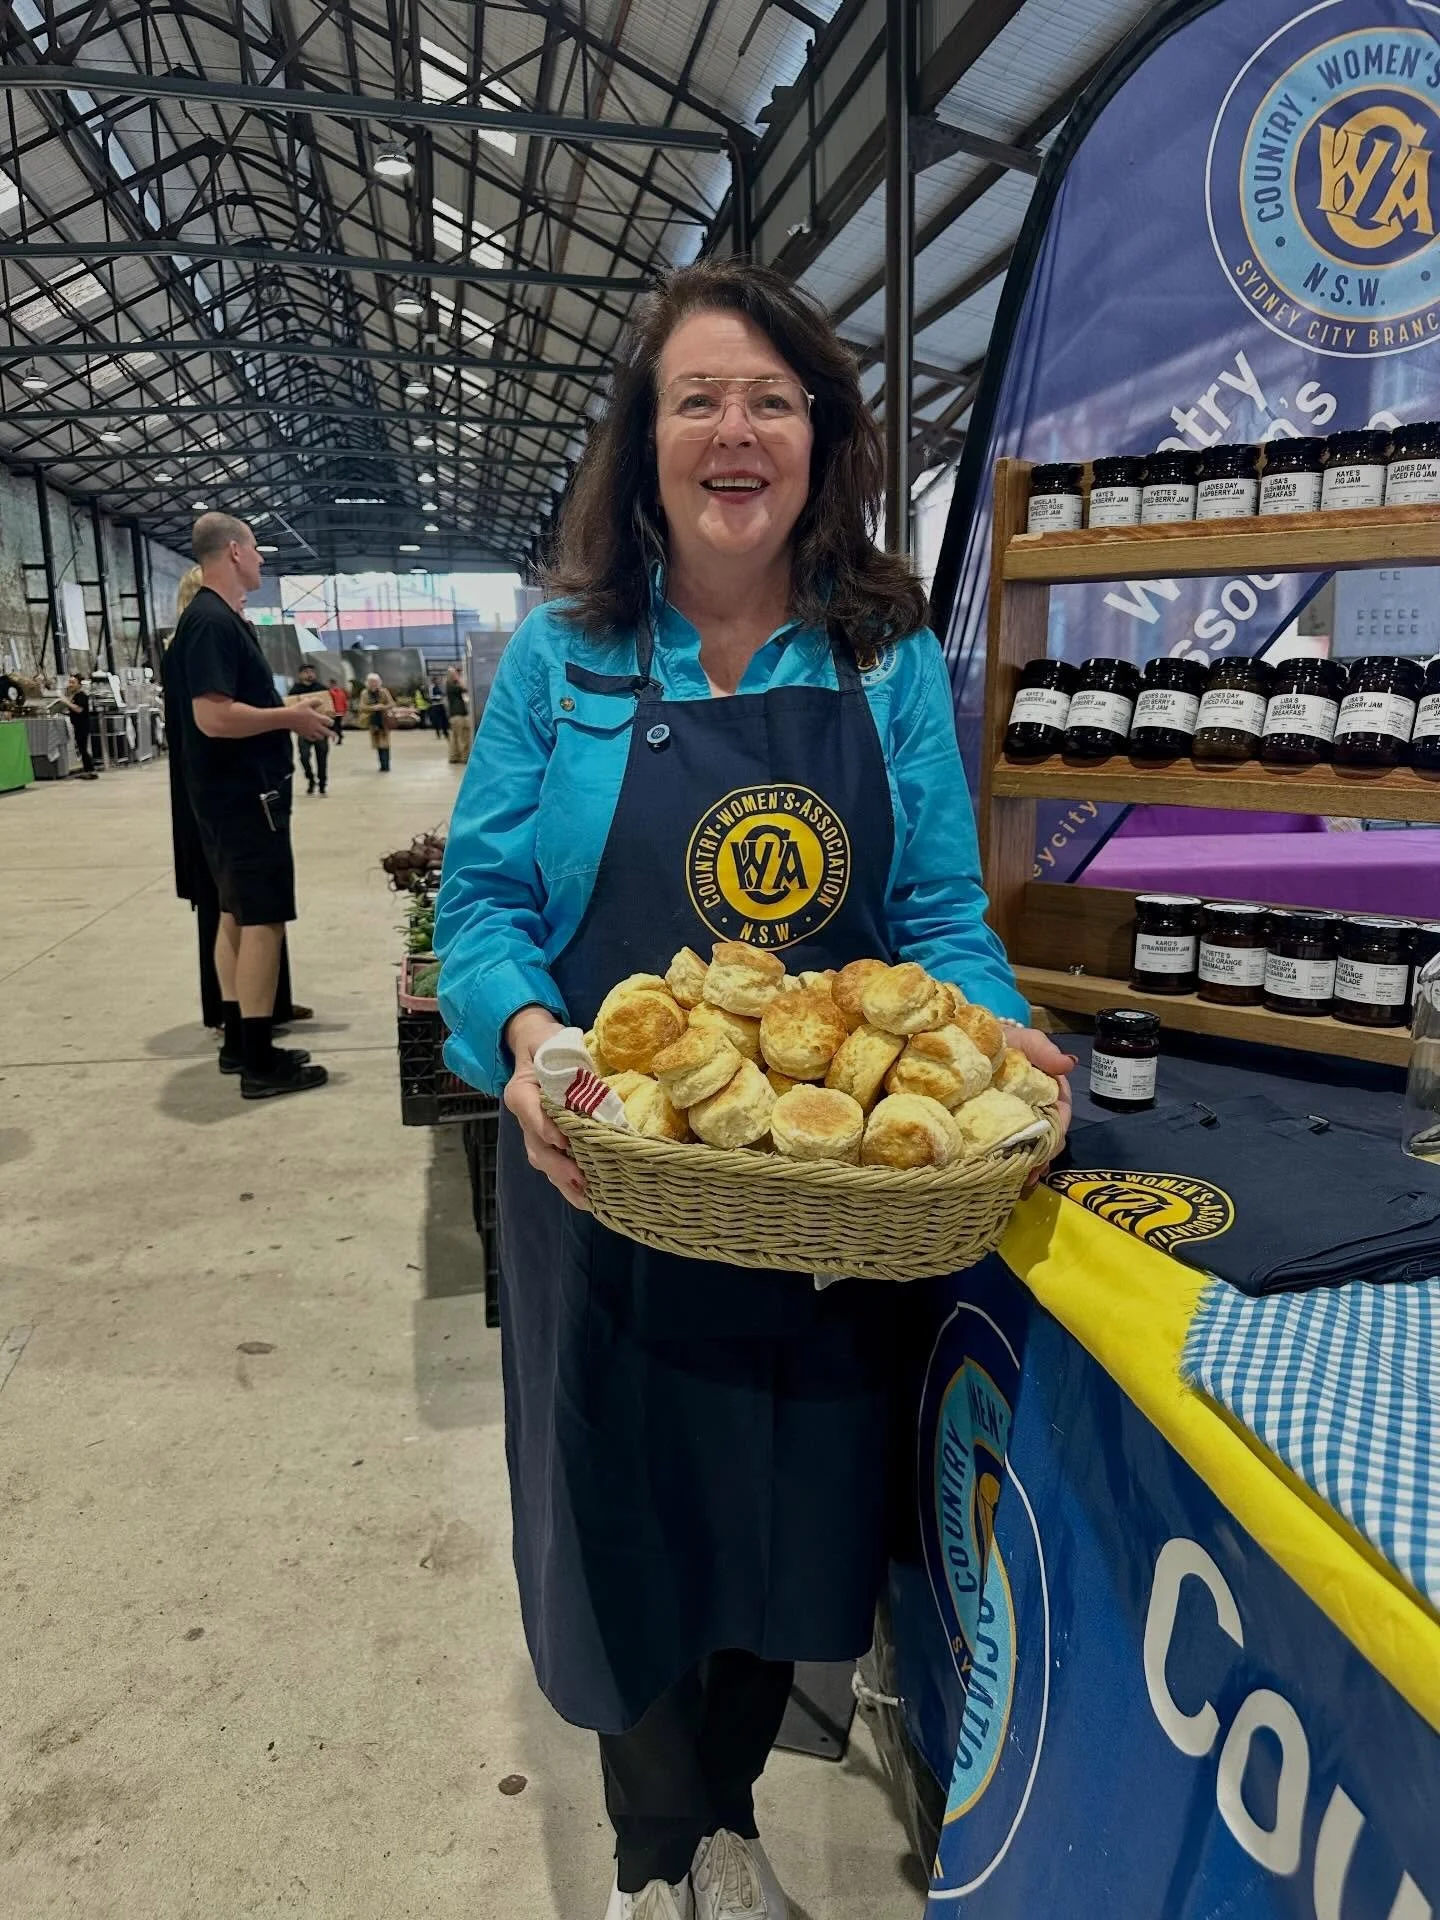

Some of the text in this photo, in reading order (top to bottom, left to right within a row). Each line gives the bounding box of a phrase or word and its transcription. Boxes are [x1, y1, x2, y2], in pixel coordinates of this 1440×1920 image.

[1254, 94, 1303, 223] COUNTRY
[1236, 260, 1301, 329] SYDNEY
[1307, 321, 1357, 348] CITY
[1336, 469, 1360, 477] KAYE'S
[1394, 463, 1432, 473] LADIES DAY
[1409, 471, 1421, 479] FIG
[1423, 470, 1437, 478] JAM
[1346, 476, 1361, 484] JAM
[1232, 488, 1245, 496] JAM
[1264, 490, 1297, 500] BREAKFAST
[695, 791, 845, 909] COUNTRY WOMEN'S ASSOCIATION
[1141, 944, 1179, 952] STRAWBERRY
[1215, 957, 1243, 966] ORANGE
[1125, 1174, 1215, 1204] WOMEN'S
[943, 1421, 979, 1594] COUNTRY
